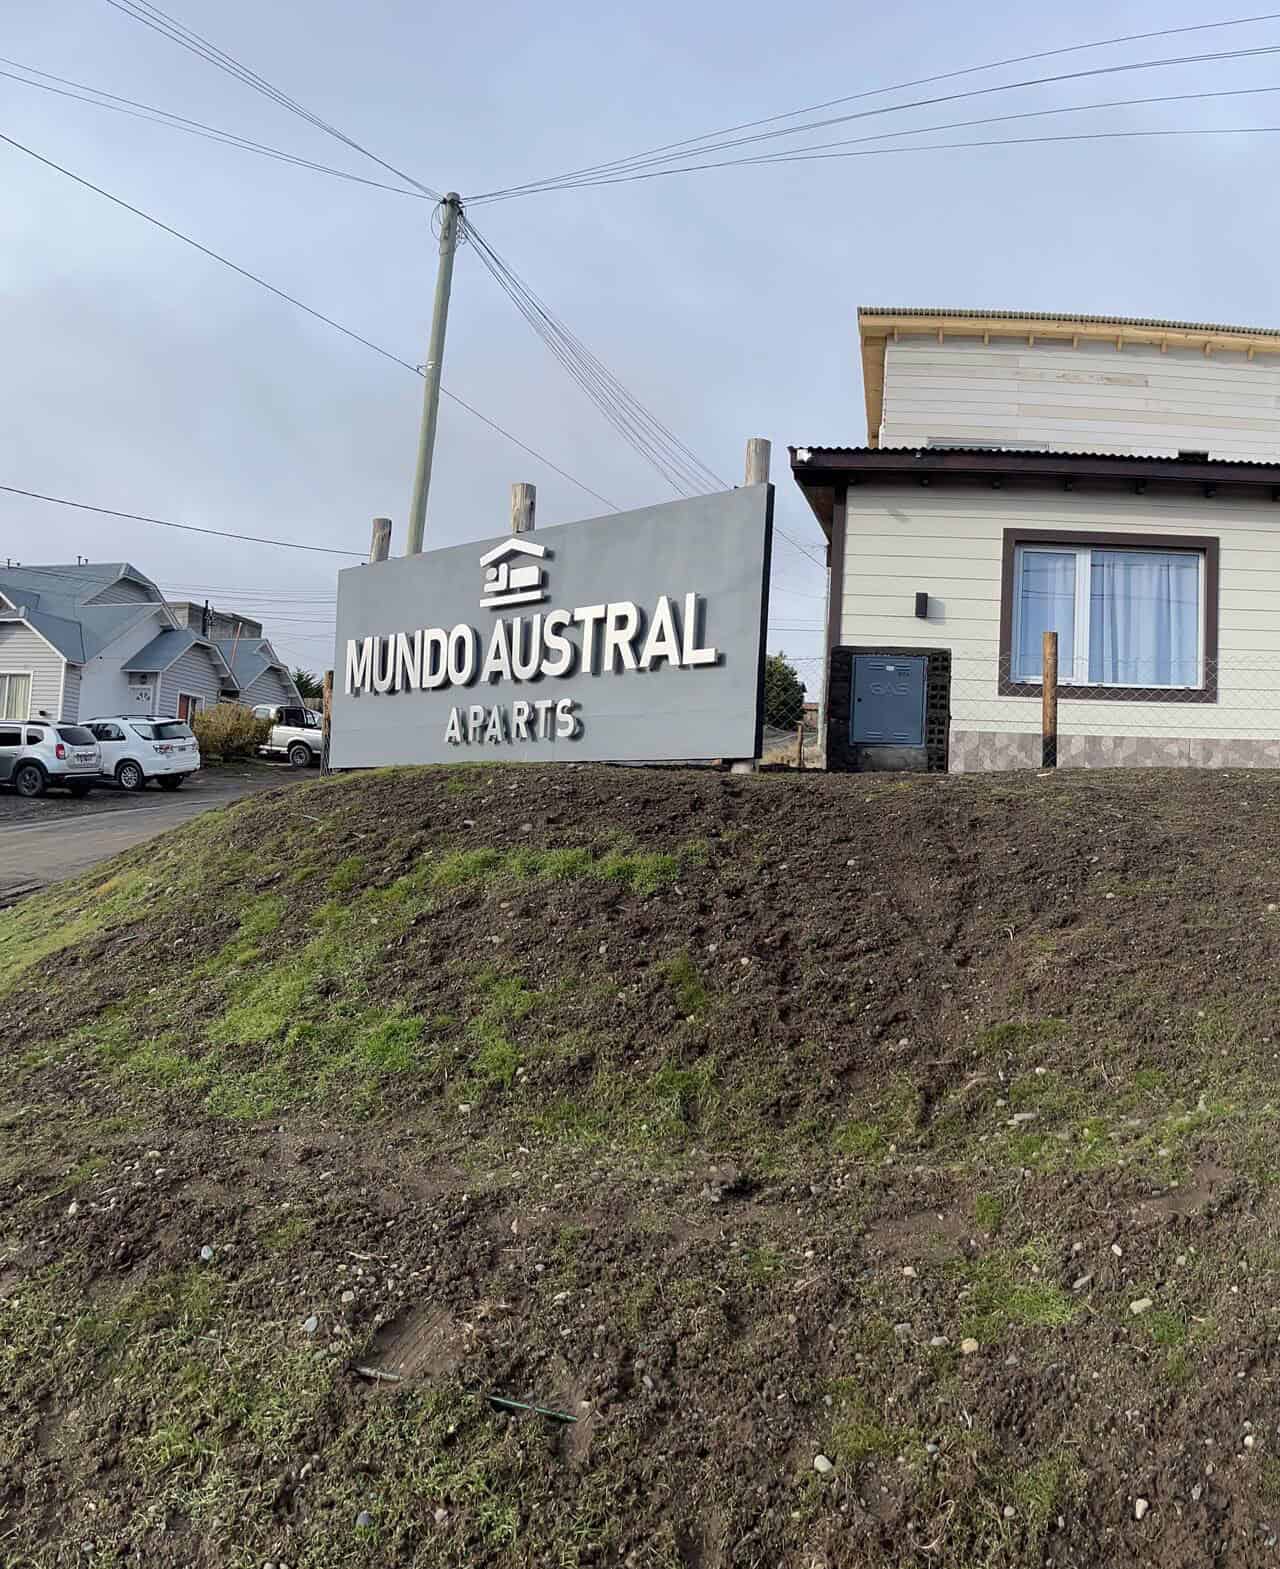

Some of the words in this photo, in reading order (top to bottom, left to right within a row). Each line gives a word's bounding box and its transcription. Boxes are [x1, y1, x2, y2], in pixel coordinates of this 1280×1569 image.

[344, 623, 474, 696] MUNDO
[479, 591, 718, 683] AUSTRAL
[444, 697, 577, 743] APARTS
